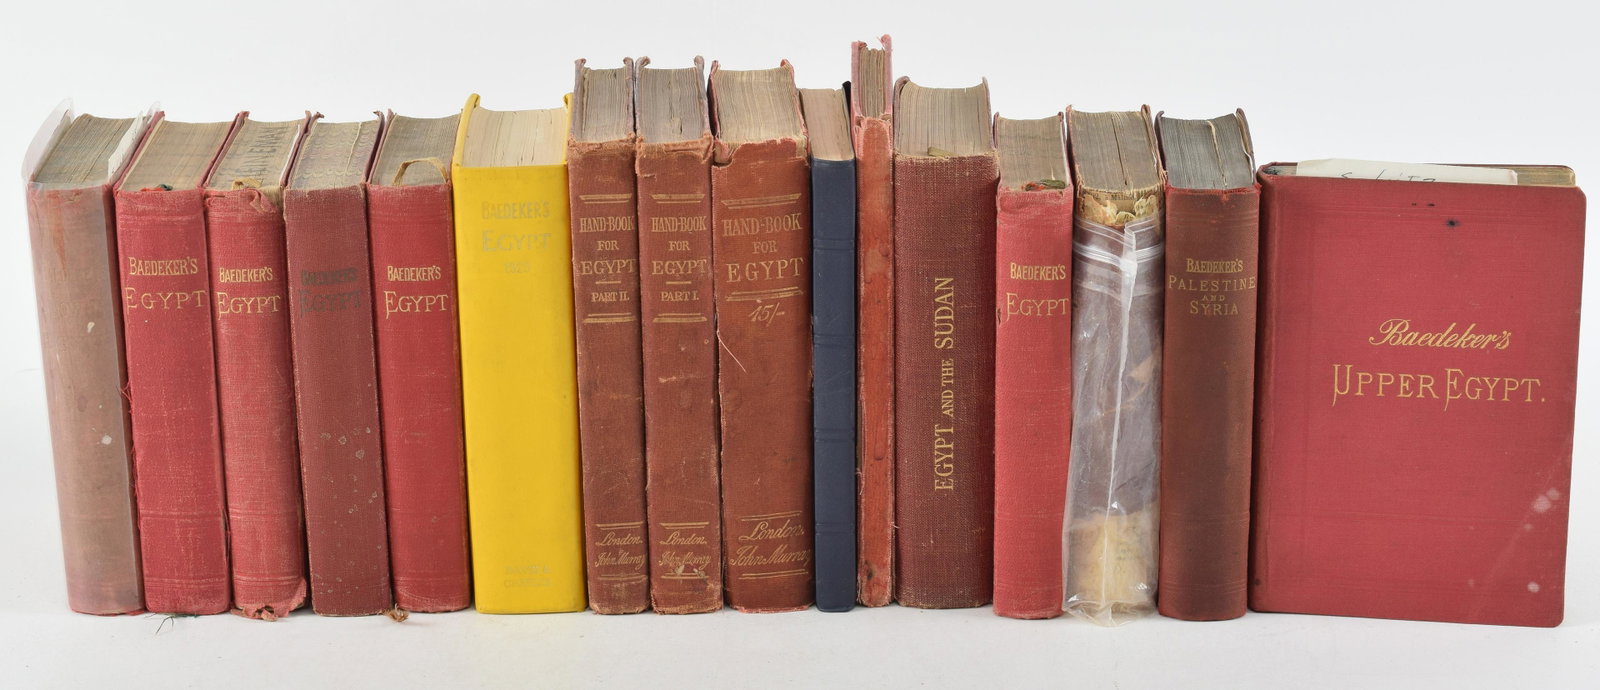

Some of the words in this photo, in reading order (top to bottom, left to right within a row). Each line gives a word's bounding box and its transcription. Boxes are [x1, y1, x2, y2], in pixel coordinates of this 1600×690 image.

[579, 216, 634, 233] HAND-BOOK
[651, 216, 707, 233] HAND-BOOK
[721, 212, 803, 237] HAND-BOOK
[481, 230, 552, 252] EGYPT
[597, 240, 619, 251] FOR
[668, 240, 690, 251] FOR
[752, 240, 777, 255] FOR
[128, 256, 198, 276] BAEDEKER'S
[387, 265, 441, 282] BAEDEKER'S
[580, 258, 636, 275] EGYPT
[651, 258, 707, 275] EGYPT
[725, 257, 804, 283] EGYPT
[1010, 262, 1066, 280] BAEDEKER'S
[1186, 257, 1244, 273] BAEDEKER'S
[219, 266, 273, 283] BAEDEKER'S
[1168, 274, 1256, 292] PALESTINE
[125, 287, 207, 315] EGYPT
[384, 290, 448, 320] EGYPT
[591, 291, 618, 302] PART
[661, 291, 691, 301] PART
[1202, 294, 1226, 302] AND
[216, 291, 281, 320] EGYPT
[935, 277, 954, 349] SUDAN
[1006, 292, 1069, 321] EGYPT
[1189, 300, 1239, 316] SYRIA
[1368, 318, 1512, 349] Baedeker's
[941, 358, 954, 385] THE
[1332, 364, 1440, 407] UPPER
[1443, 368, 1545, 411] EGYPT.
[941, 389, 954, 418] AND
[935, 424, 954, 491] EGYPT
